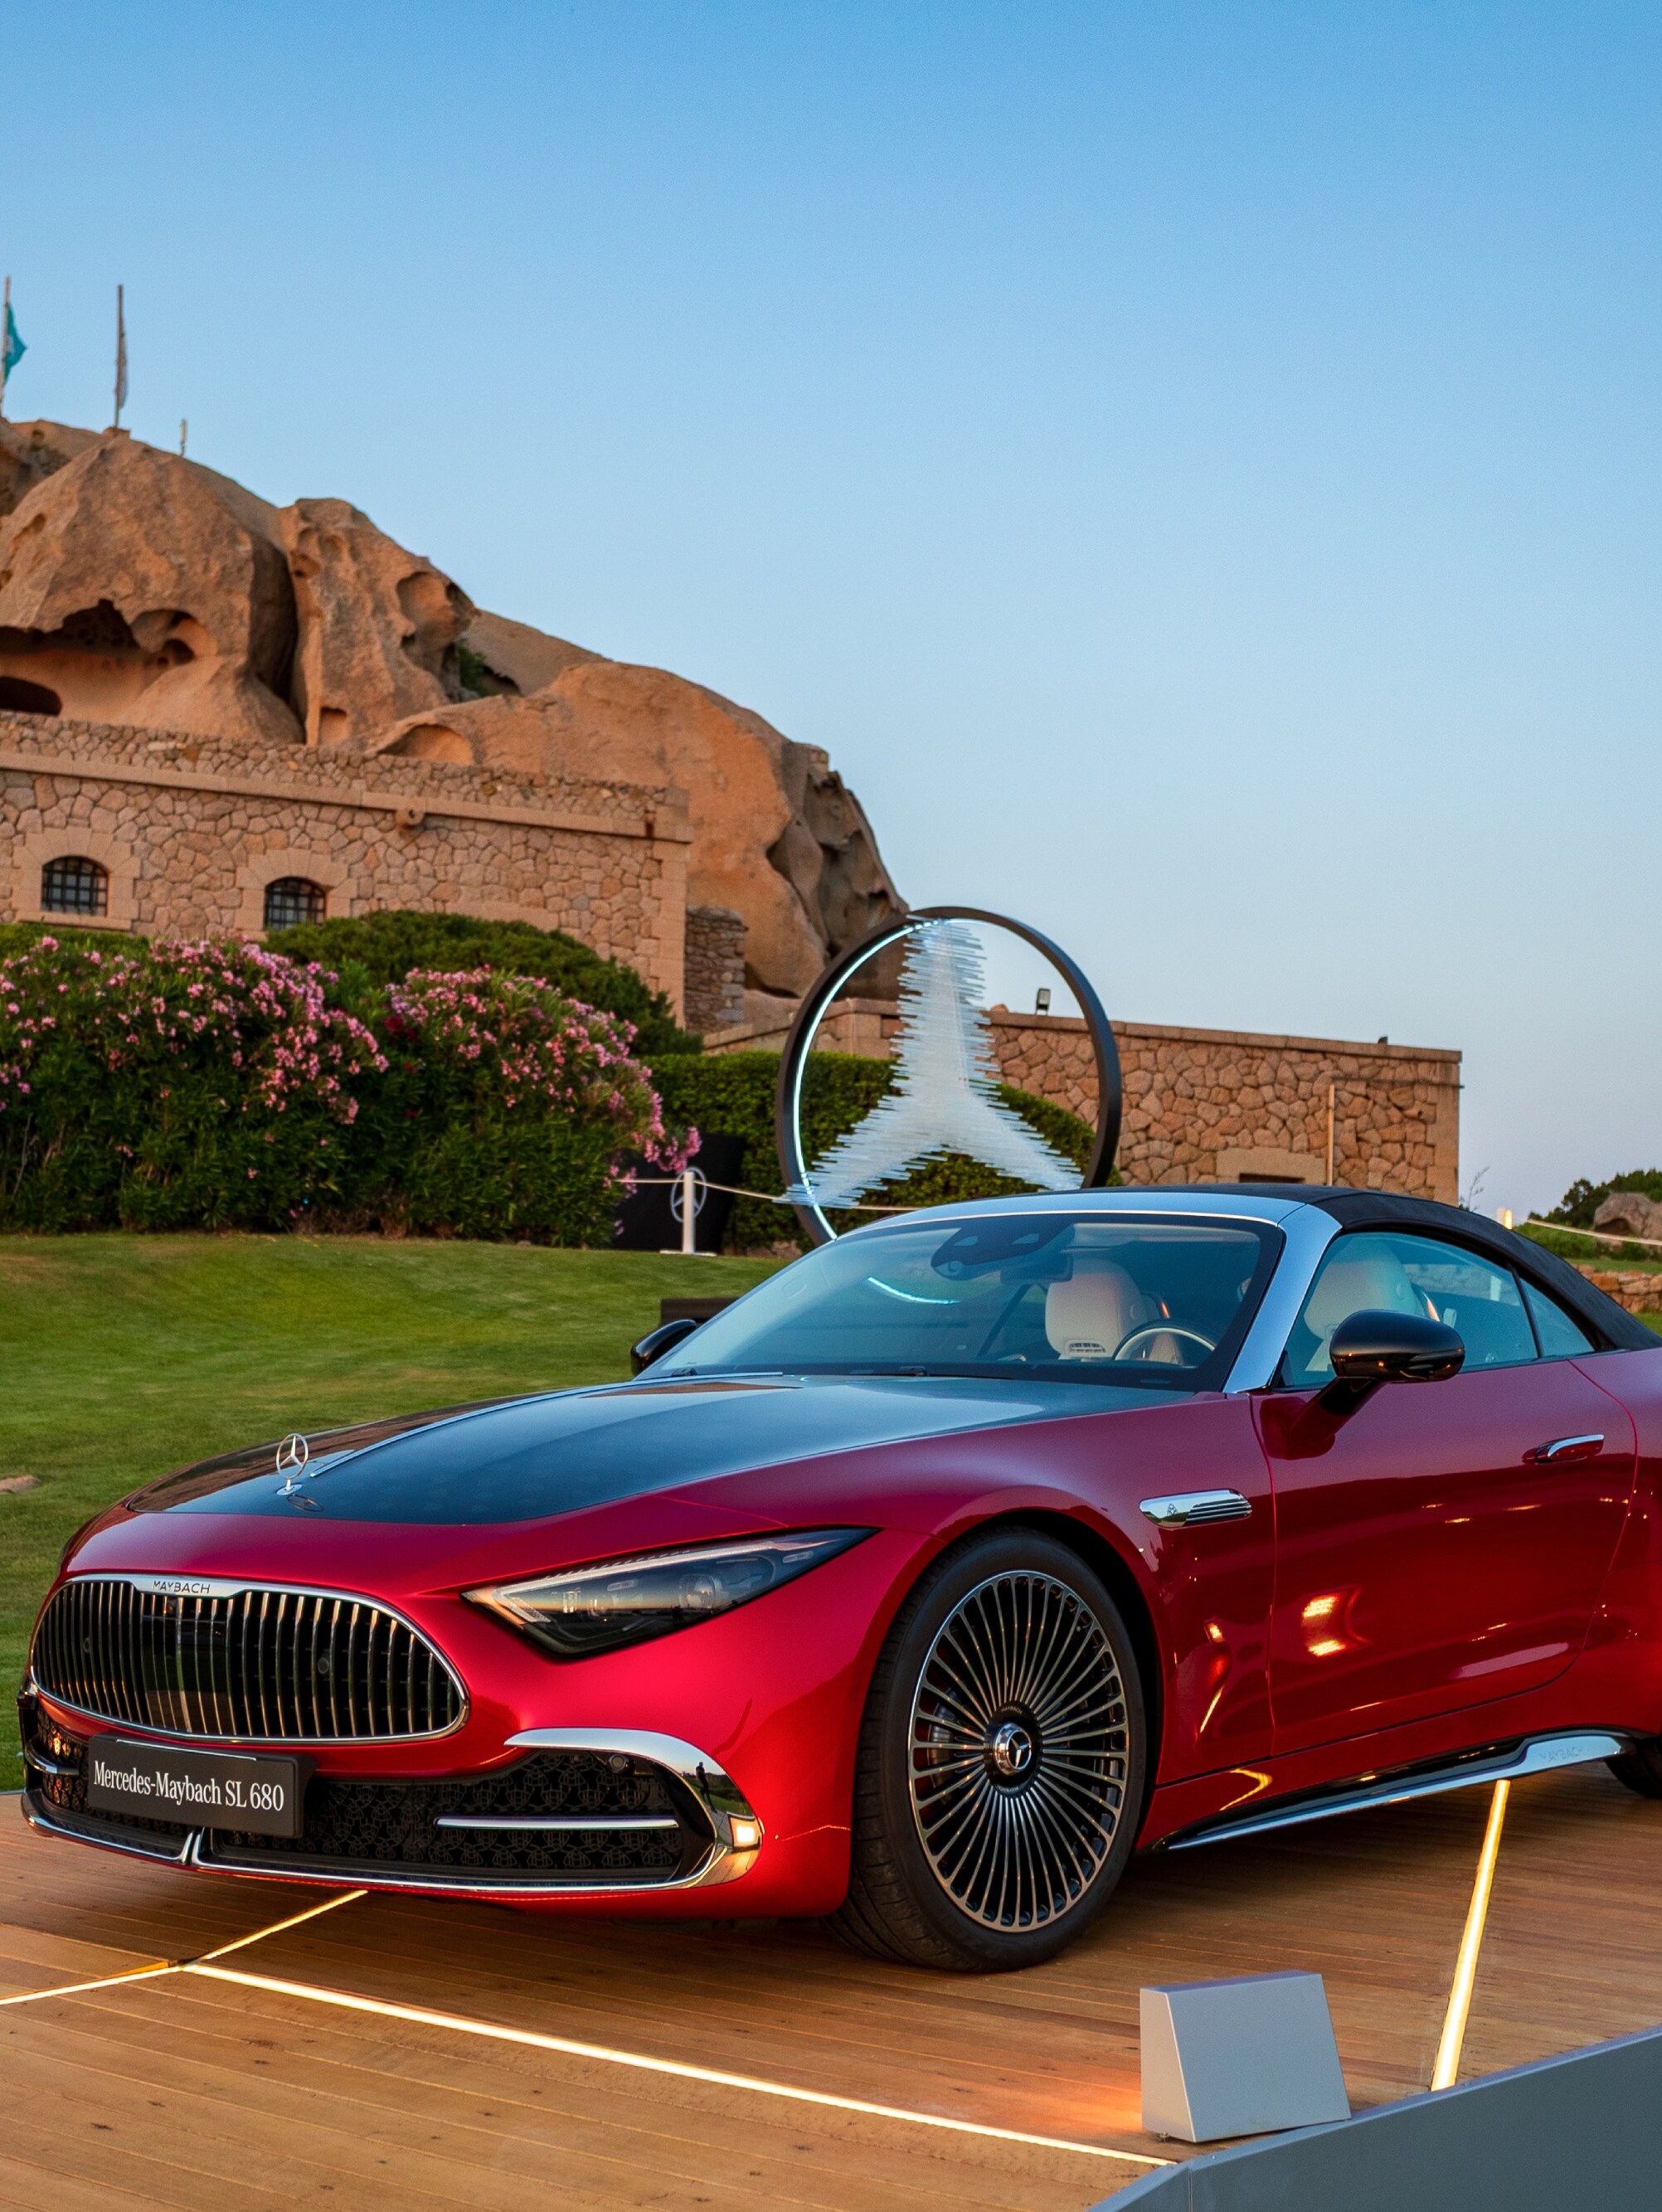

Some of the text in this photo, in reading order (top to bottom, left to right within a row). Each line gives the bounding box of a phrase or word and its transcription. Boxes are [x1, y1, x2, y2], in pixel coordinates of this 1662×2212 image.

[153, 1580, 211, 1593] MAYBACH
[94, 1760, 284, 1811] Mercedes-Maybach SL 680
